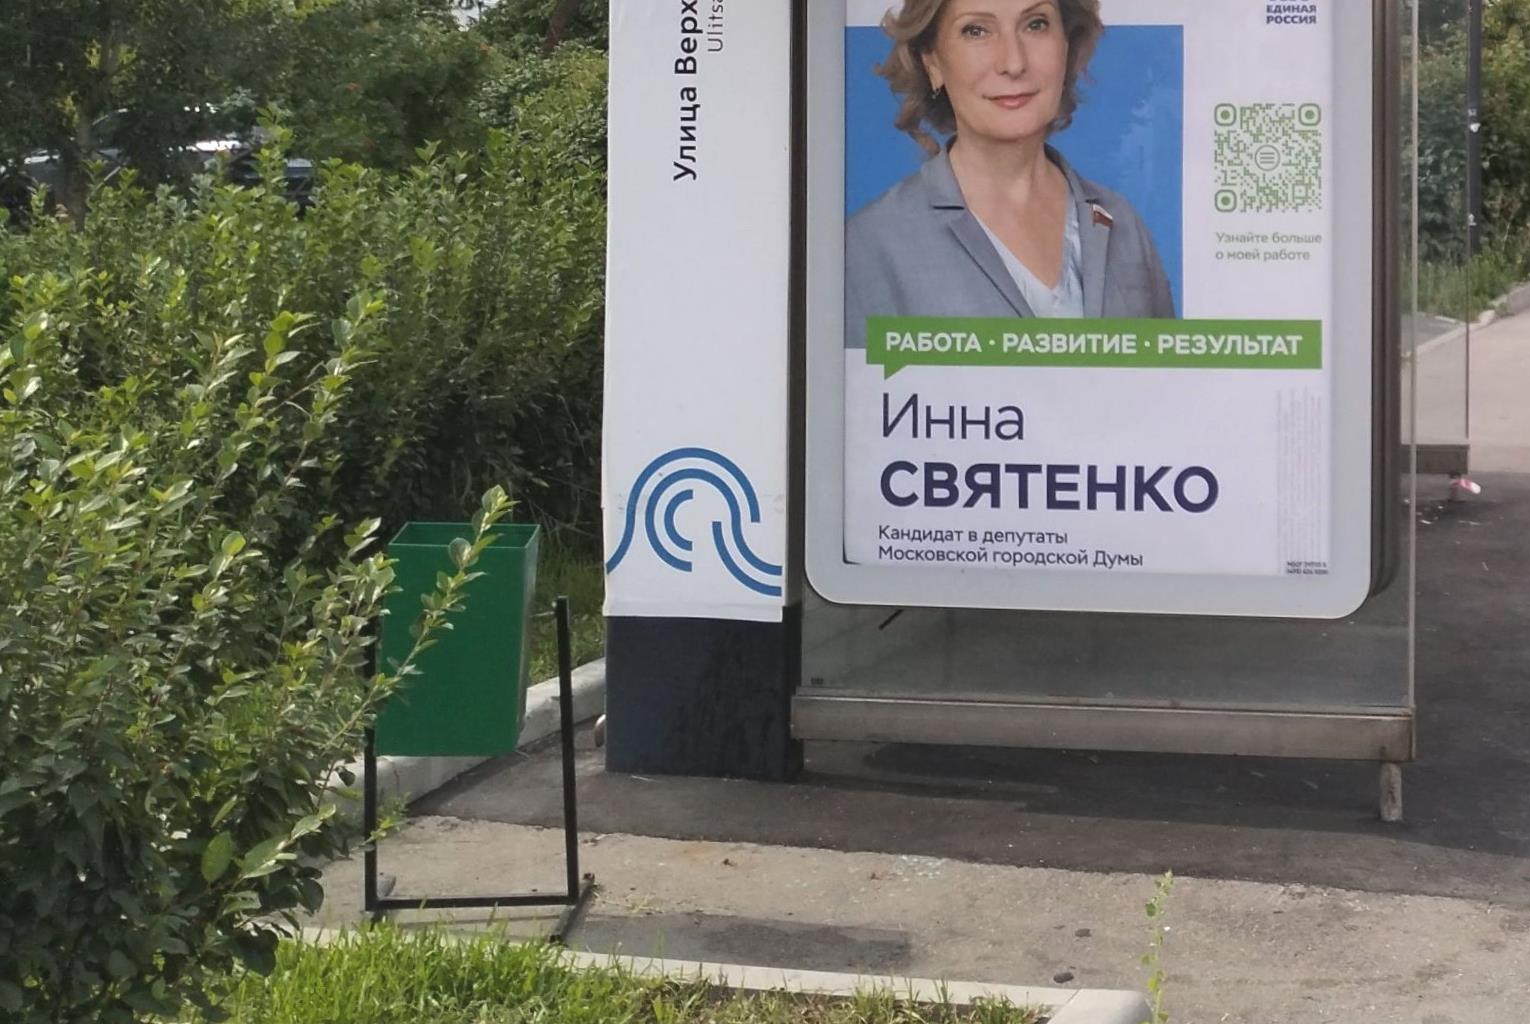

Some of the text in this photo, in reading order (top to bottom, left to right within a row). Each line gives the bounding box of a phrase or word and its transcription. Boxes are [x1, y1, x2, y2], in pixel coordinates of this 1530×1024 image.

[1266, 4, 1317, 14] ЕДИНАЯ
[1266, 15, 1317, 25] РОССИЯ
[673, 86, 702, 181] Улица
[1215, 231, 1322, 244] Узнайте больше
[1215, 248, 1311, 262] о моей работе
[885, 332, 1303, 357] РАБОТА РАЗВИТИЕ РЕЗУЛЬТАТ
[882, 392, 1025, 441] Инна
[880, 460, 1220, 514] СВЯТЕНКО
[878, 524, 1069, 548] Кандидат в депутаты
[878, 544, 1144, 569] Московской городской Думы
